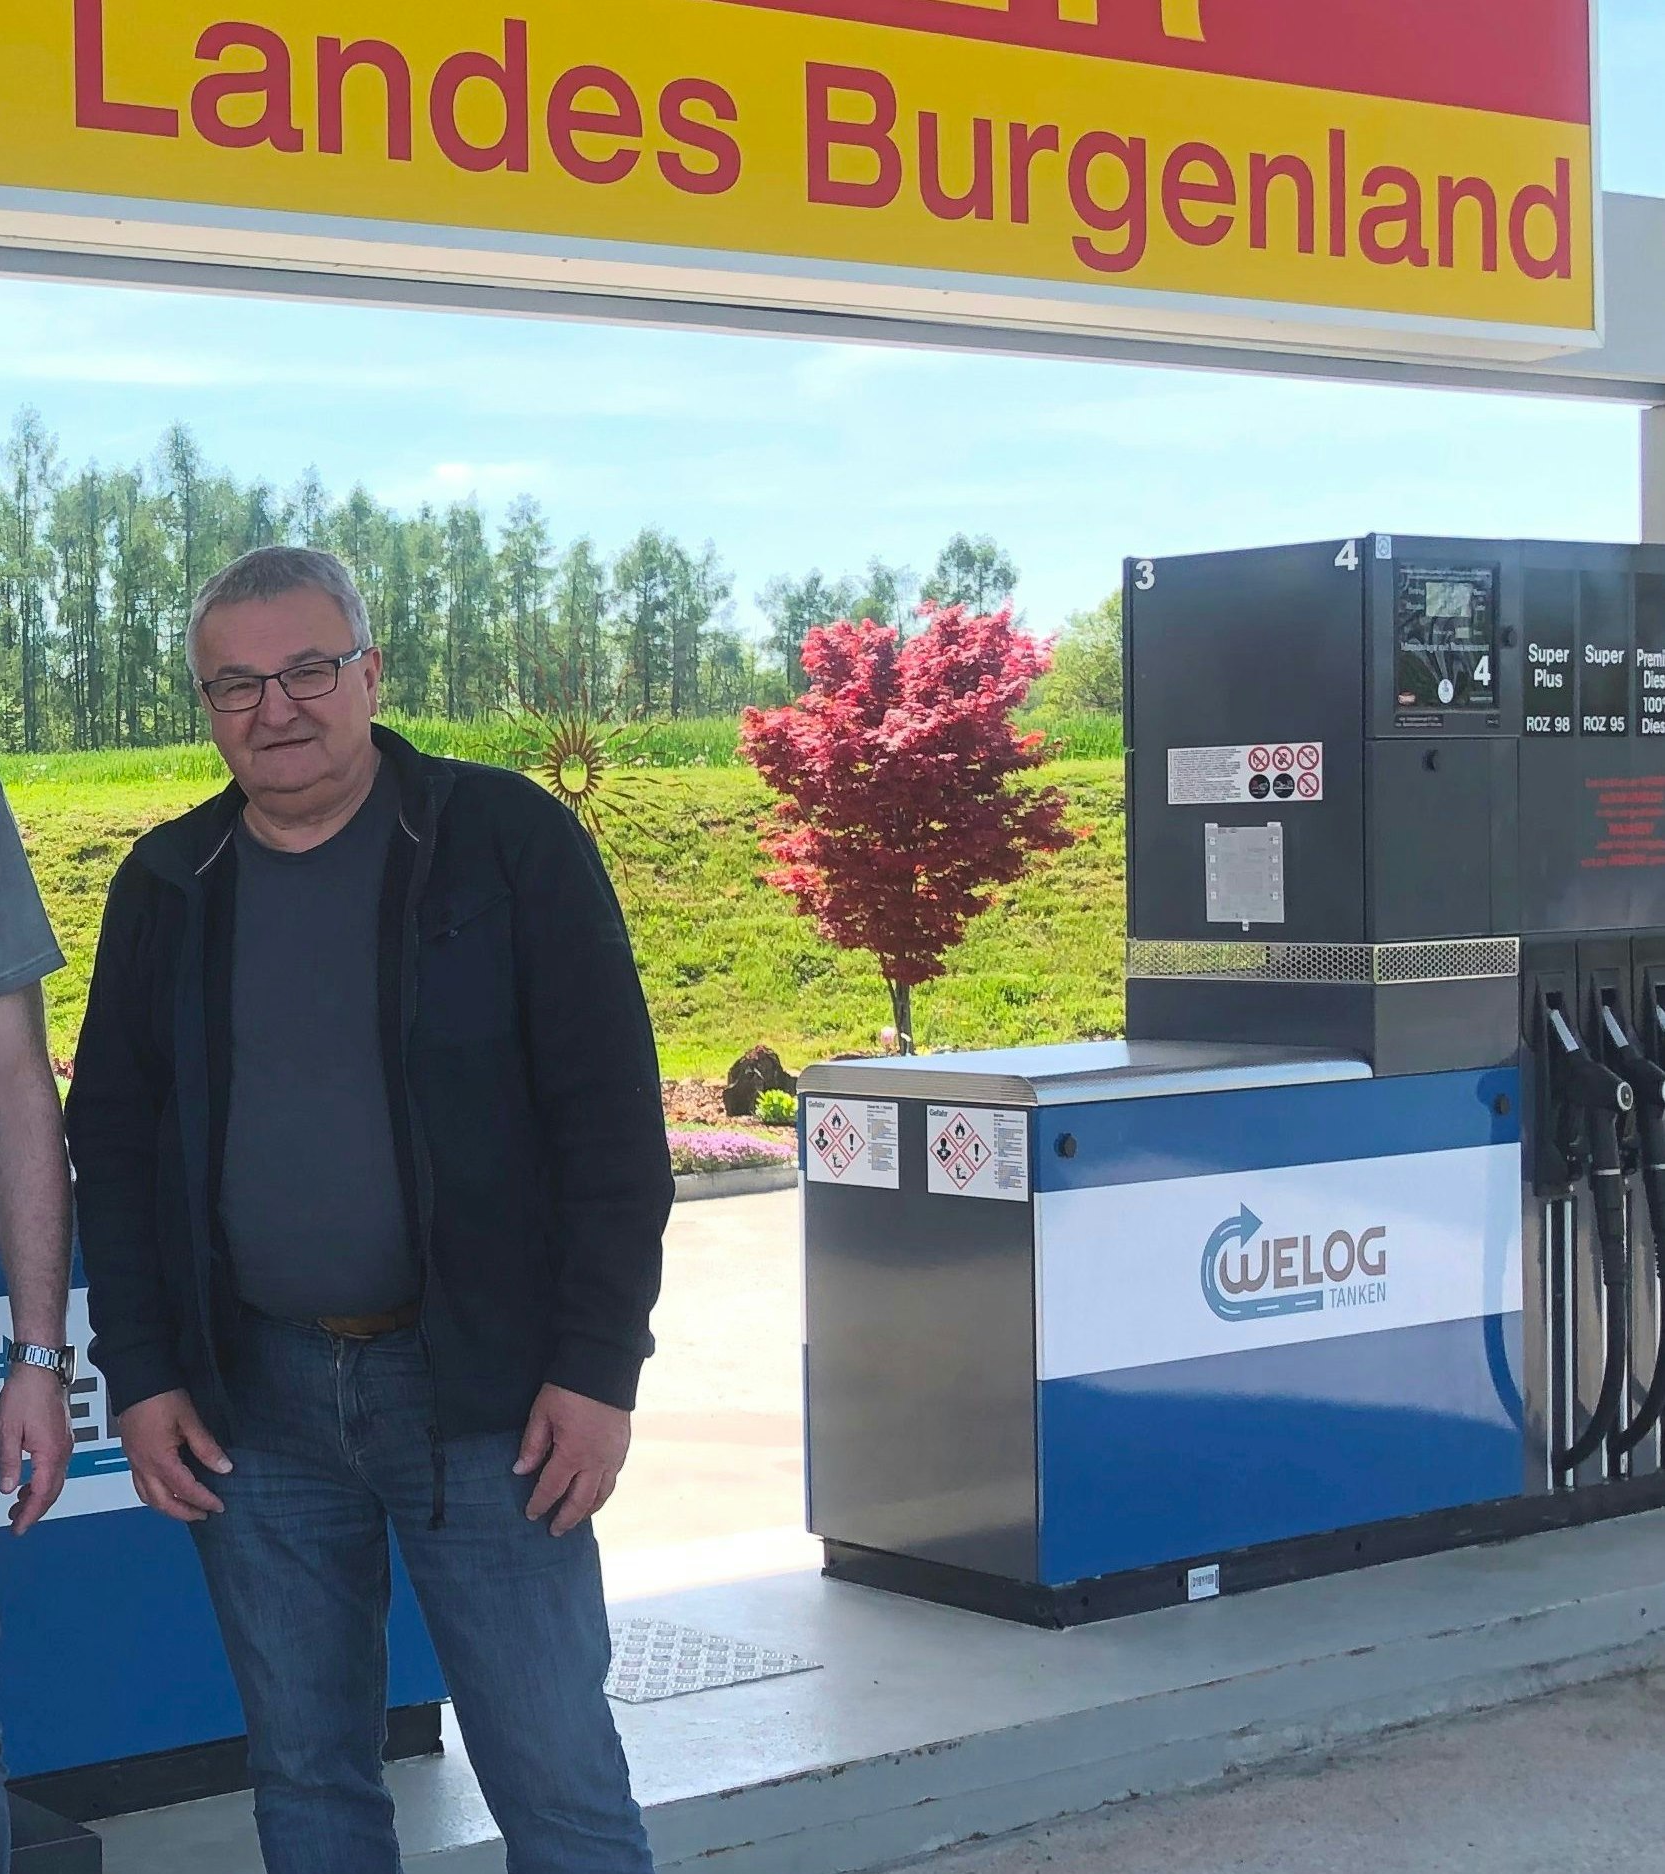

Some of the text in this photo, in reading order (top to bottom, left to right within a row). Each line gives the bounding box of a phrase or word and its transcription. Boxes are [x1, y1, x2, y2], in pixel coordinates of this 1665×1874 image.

[74, 0, 742, 195] Landes
[805, 61, 1573, 281] Burgenland
[1334, 539, 1359, 571] 4
[1135, 559, 1156, 590] 3
[1528, 643, 1570, 667] Super
[1584, 644, 1625, 668] Super
[1473, 655, 1492, 687] 4
[1534, 668, 1563, 688] Plus
[1526, 716, 1570, 732] ROZ 98
[1583, 716, 1625, 732] ROZ 95
[929, 1108, 949, 1118] Gefahr
[1219, 1225, 1386, 1295] WELOG
[1328, 1282, 1386, 1309] TANKEN
